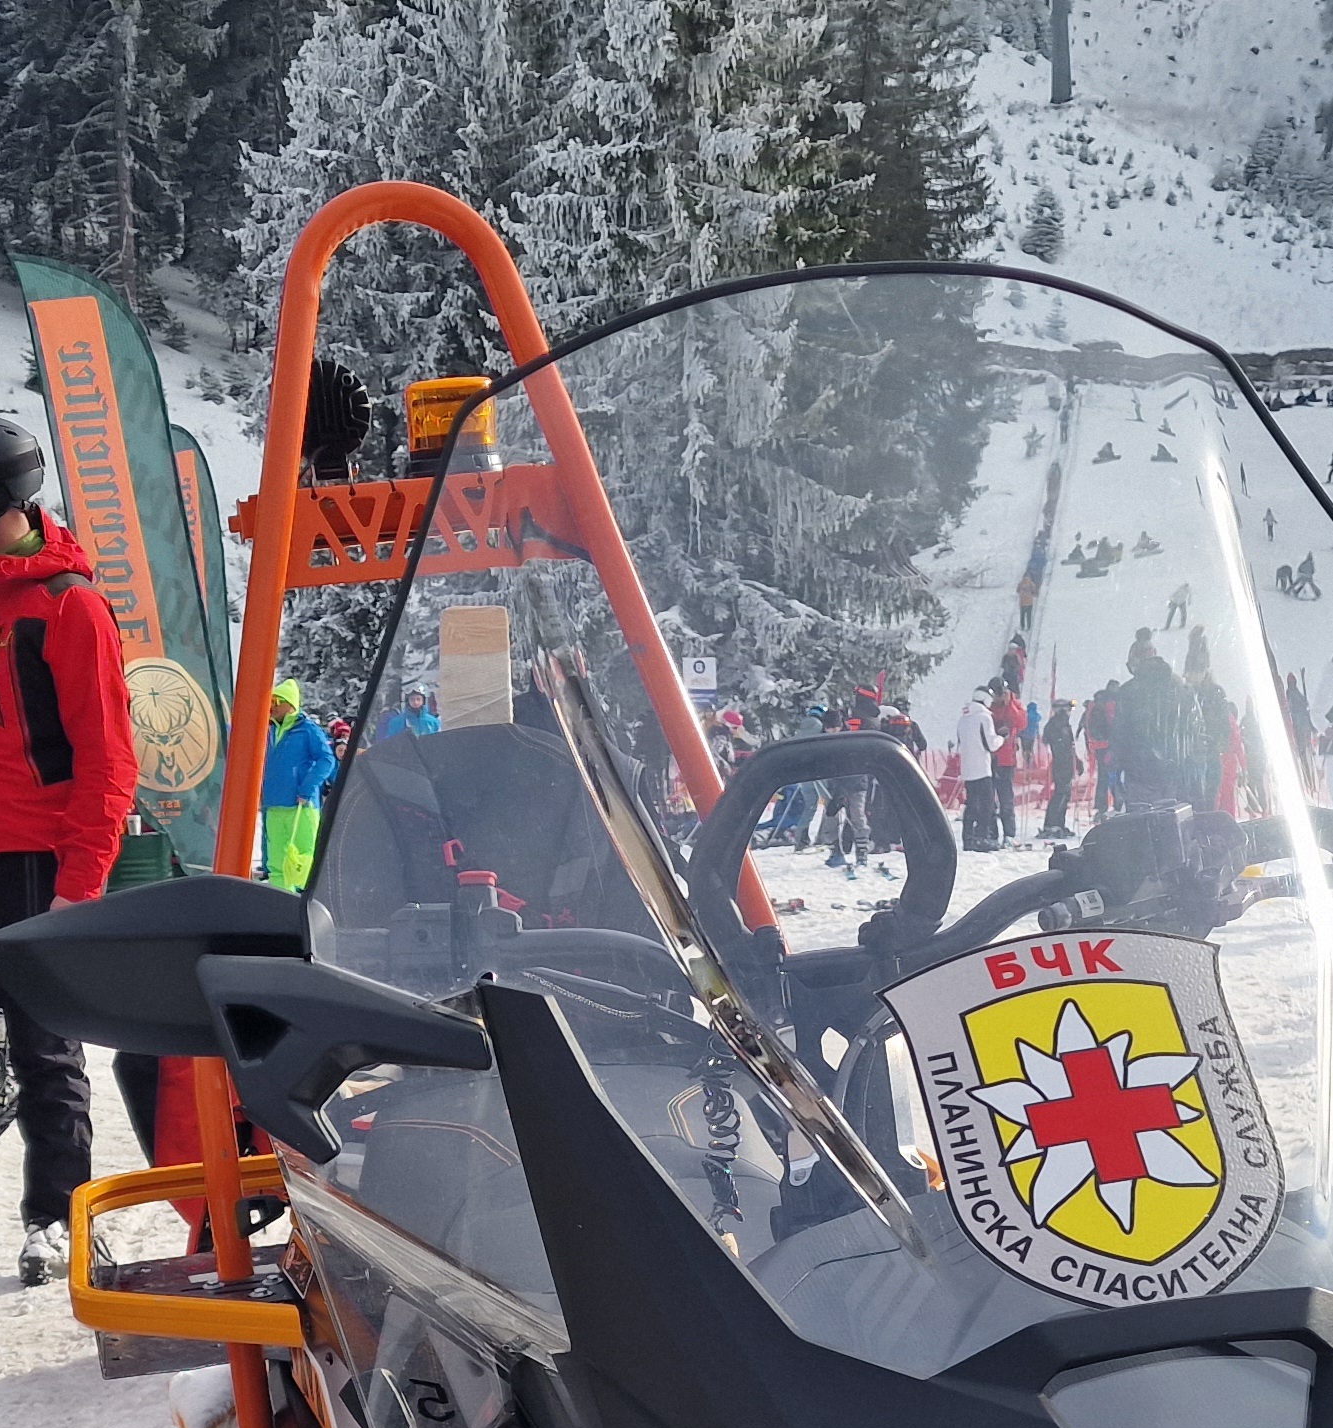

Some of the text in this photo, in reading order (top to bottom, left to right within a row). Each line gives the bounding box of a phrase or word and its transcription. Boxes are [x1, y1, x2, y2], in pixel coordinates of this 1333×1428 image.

[984, 938, 1124, 990] БЧК
[927, 1015, 1270, 1302] ПЛАНИНСКА СПАСИТЕЛНА СЛУЖБА
